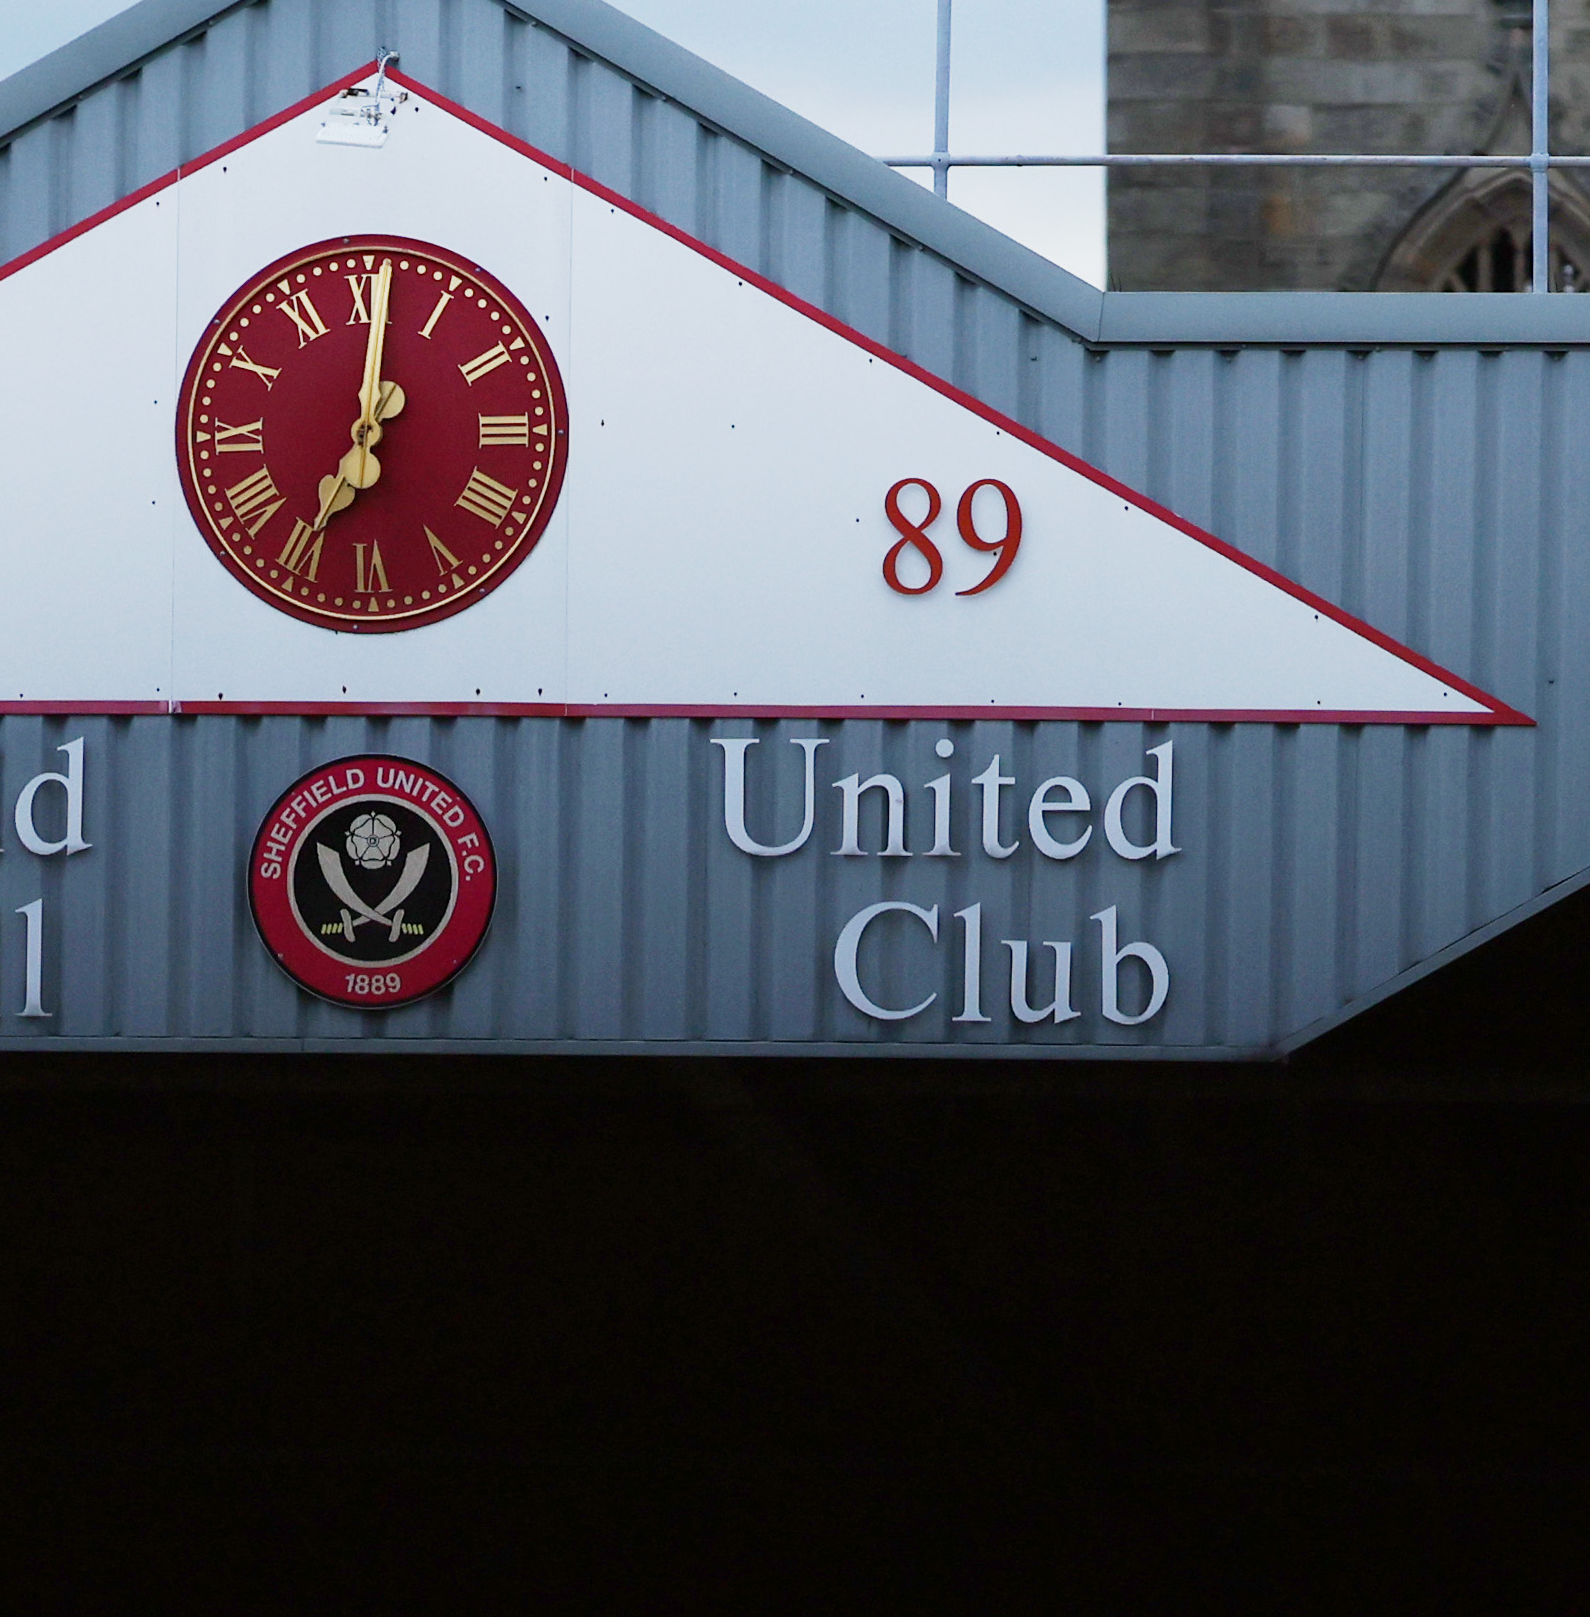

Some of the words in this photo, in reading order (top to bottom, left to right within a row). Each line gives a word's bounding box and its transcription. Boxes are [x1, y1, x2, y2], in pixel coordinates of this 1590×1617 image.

[276, 288, 331, 349] XI
[344, 273, 392, 325] XI
[418, 290, 454, 340] I
[229, 345, 282, 391] X
[458, 340, 512, 386] II
[214, 416, 264, 456] IX
[478, 411, 529, 449] III
[224, 463, 287, 540] VIII
[453, 465, 518, 529] IIII
[275, 516, 325, 583] VII
[423, 525, 463, 576] V
[883, 477, 1023, 596] 89
[352, 539, 393, 593] VI
[261, 768, 365, 880] SHEFFIELD
[376, 767, 465, 828] UNITED
[457, 832, 485, 881] F.C.
[710, 737, 1182, 860] United
[345, 973, 401, 995] 1889
[834, 901, 1169, 1025] Club
